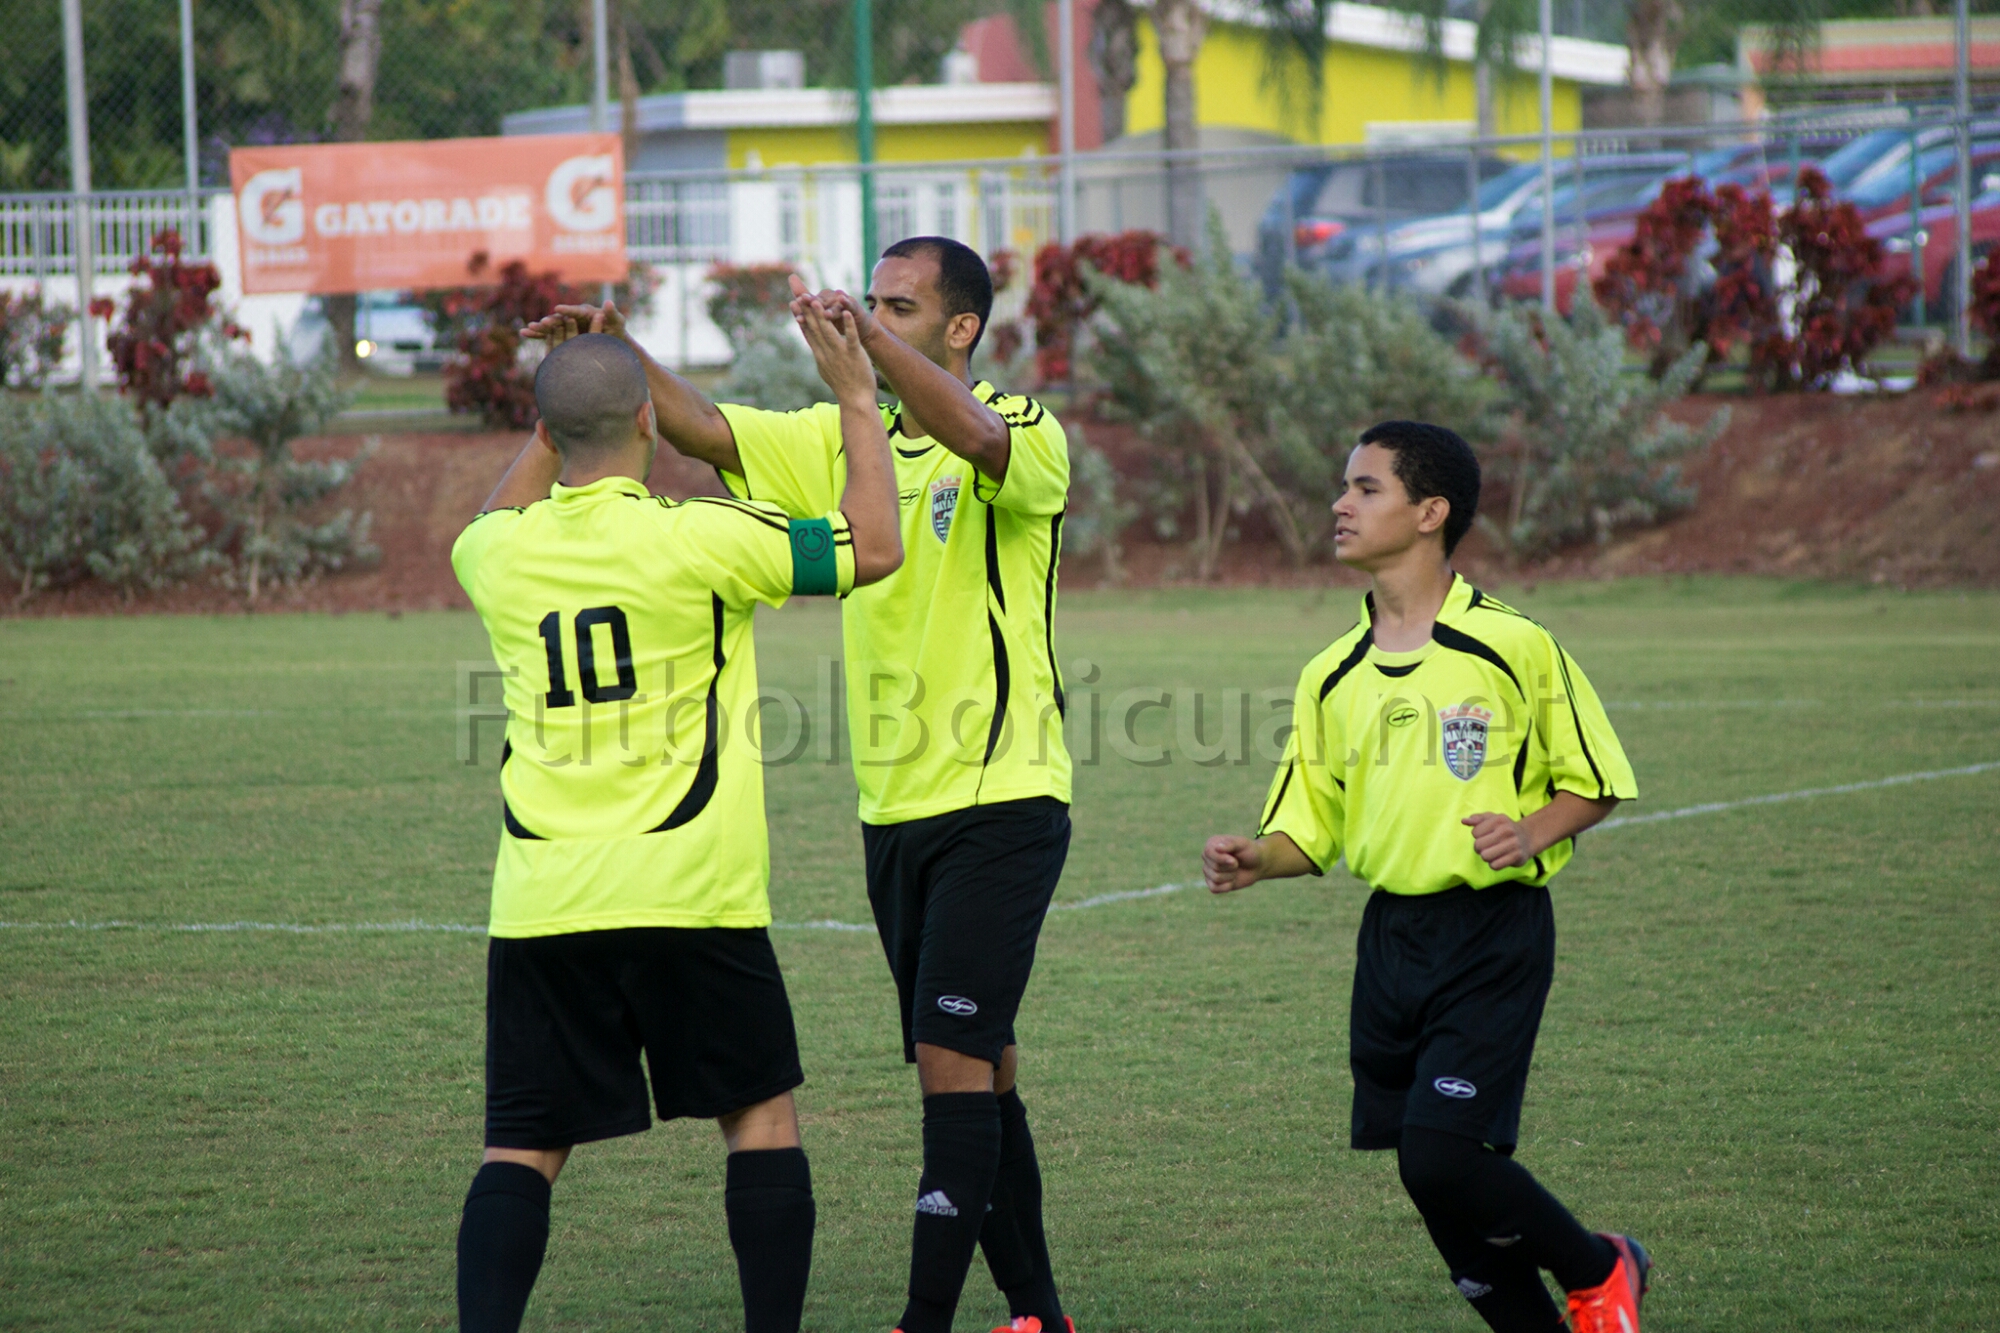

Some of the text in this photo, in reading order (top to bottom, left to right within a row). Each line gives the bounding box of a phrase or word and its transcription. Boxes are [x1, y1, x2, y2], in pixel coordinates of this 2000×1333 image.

[241, 168, 304, 245] G
[314, 196, 532, 237] GATORADE
[546, 155, 615, 231] G
[538, 605, 638, 708] 10
